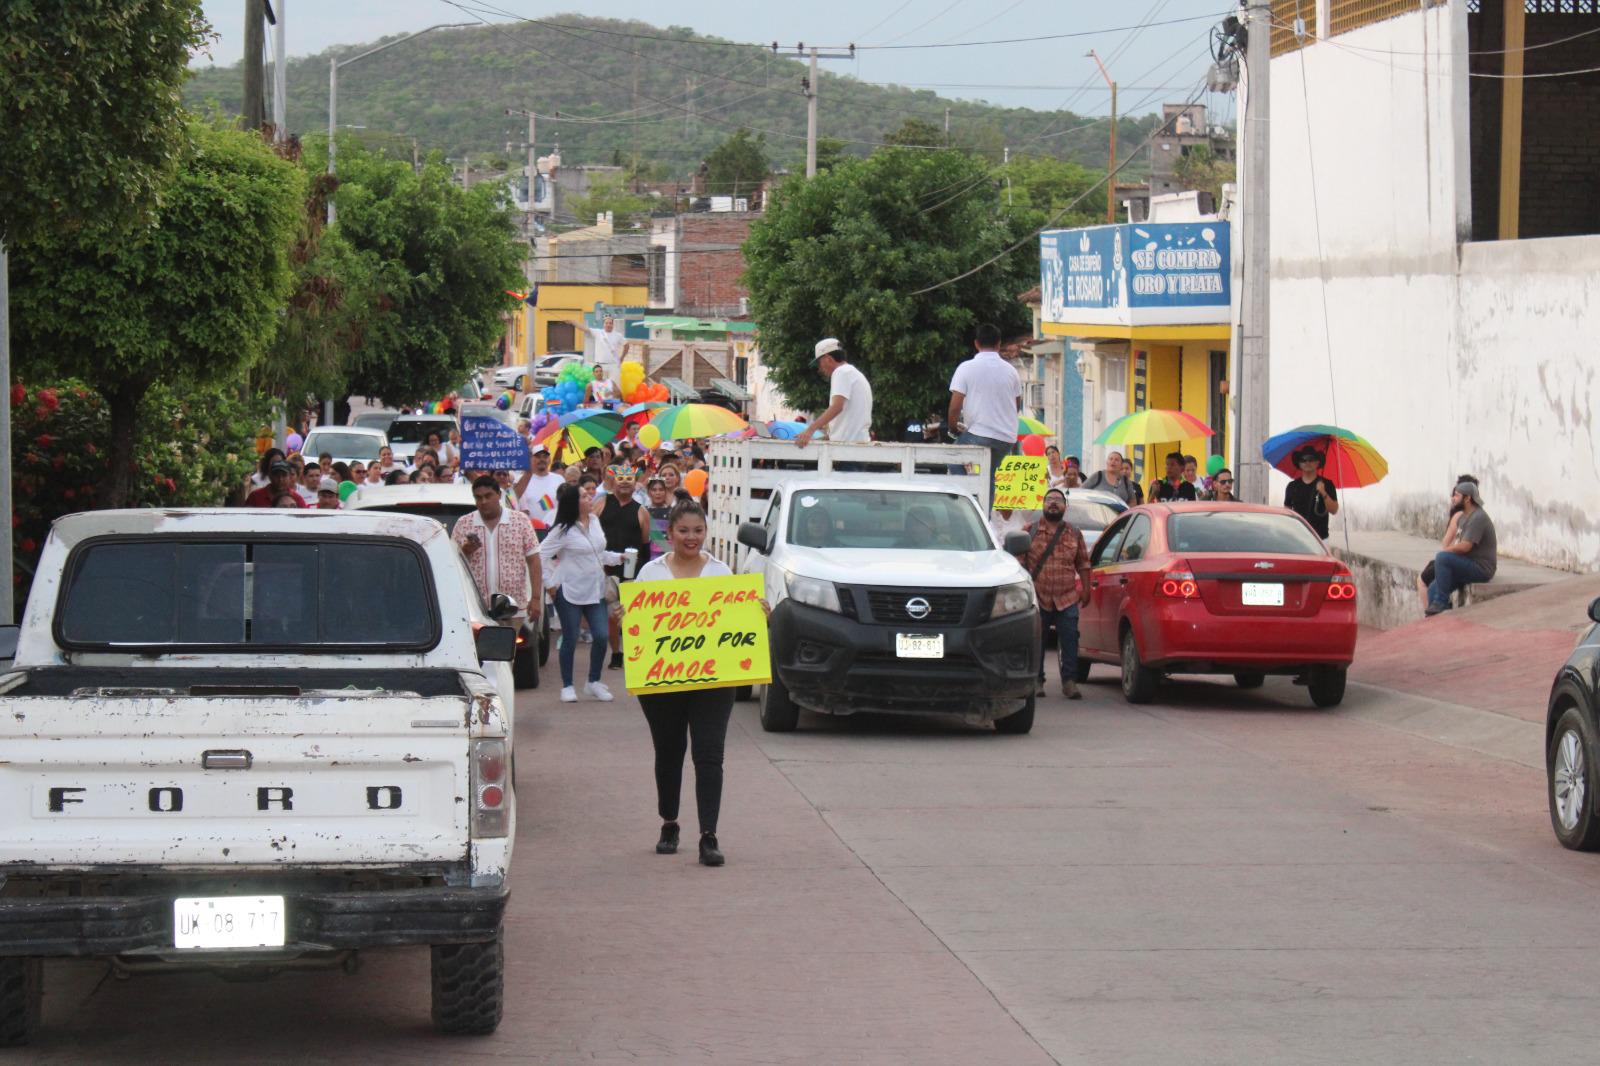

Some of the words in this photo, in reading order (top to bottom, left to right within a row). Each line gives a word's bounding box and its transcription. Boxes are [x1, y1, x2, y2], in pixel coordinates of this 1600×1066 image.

[1136, 250, 1154, 270] SE
[1156, 249, 1220, 270] COMPRA
[1068, 275, 1076, 301] EL
[1076, 275, 1103, 301] ROSARIO
[1133, 274, 1166, 294] ORO
[1166, 274, 1178, 294] Y
[1178, 273, 1223, 294] PLATA
[907, 424, 921, 433] 46
[995, 494, 1027, 506] MOR
[628, 590, 691, 612] AMOR
[708, 589, 759, 606] PARA
[653, 609, 721, 632] TODOS
[655, 635, 706, 655] TODO
[718, 631, 757, 649] POR
[646, 657, 716, 681] AMOR
[48, 786, 402, 812] FORD
[181, 912, 200, 935] UK
